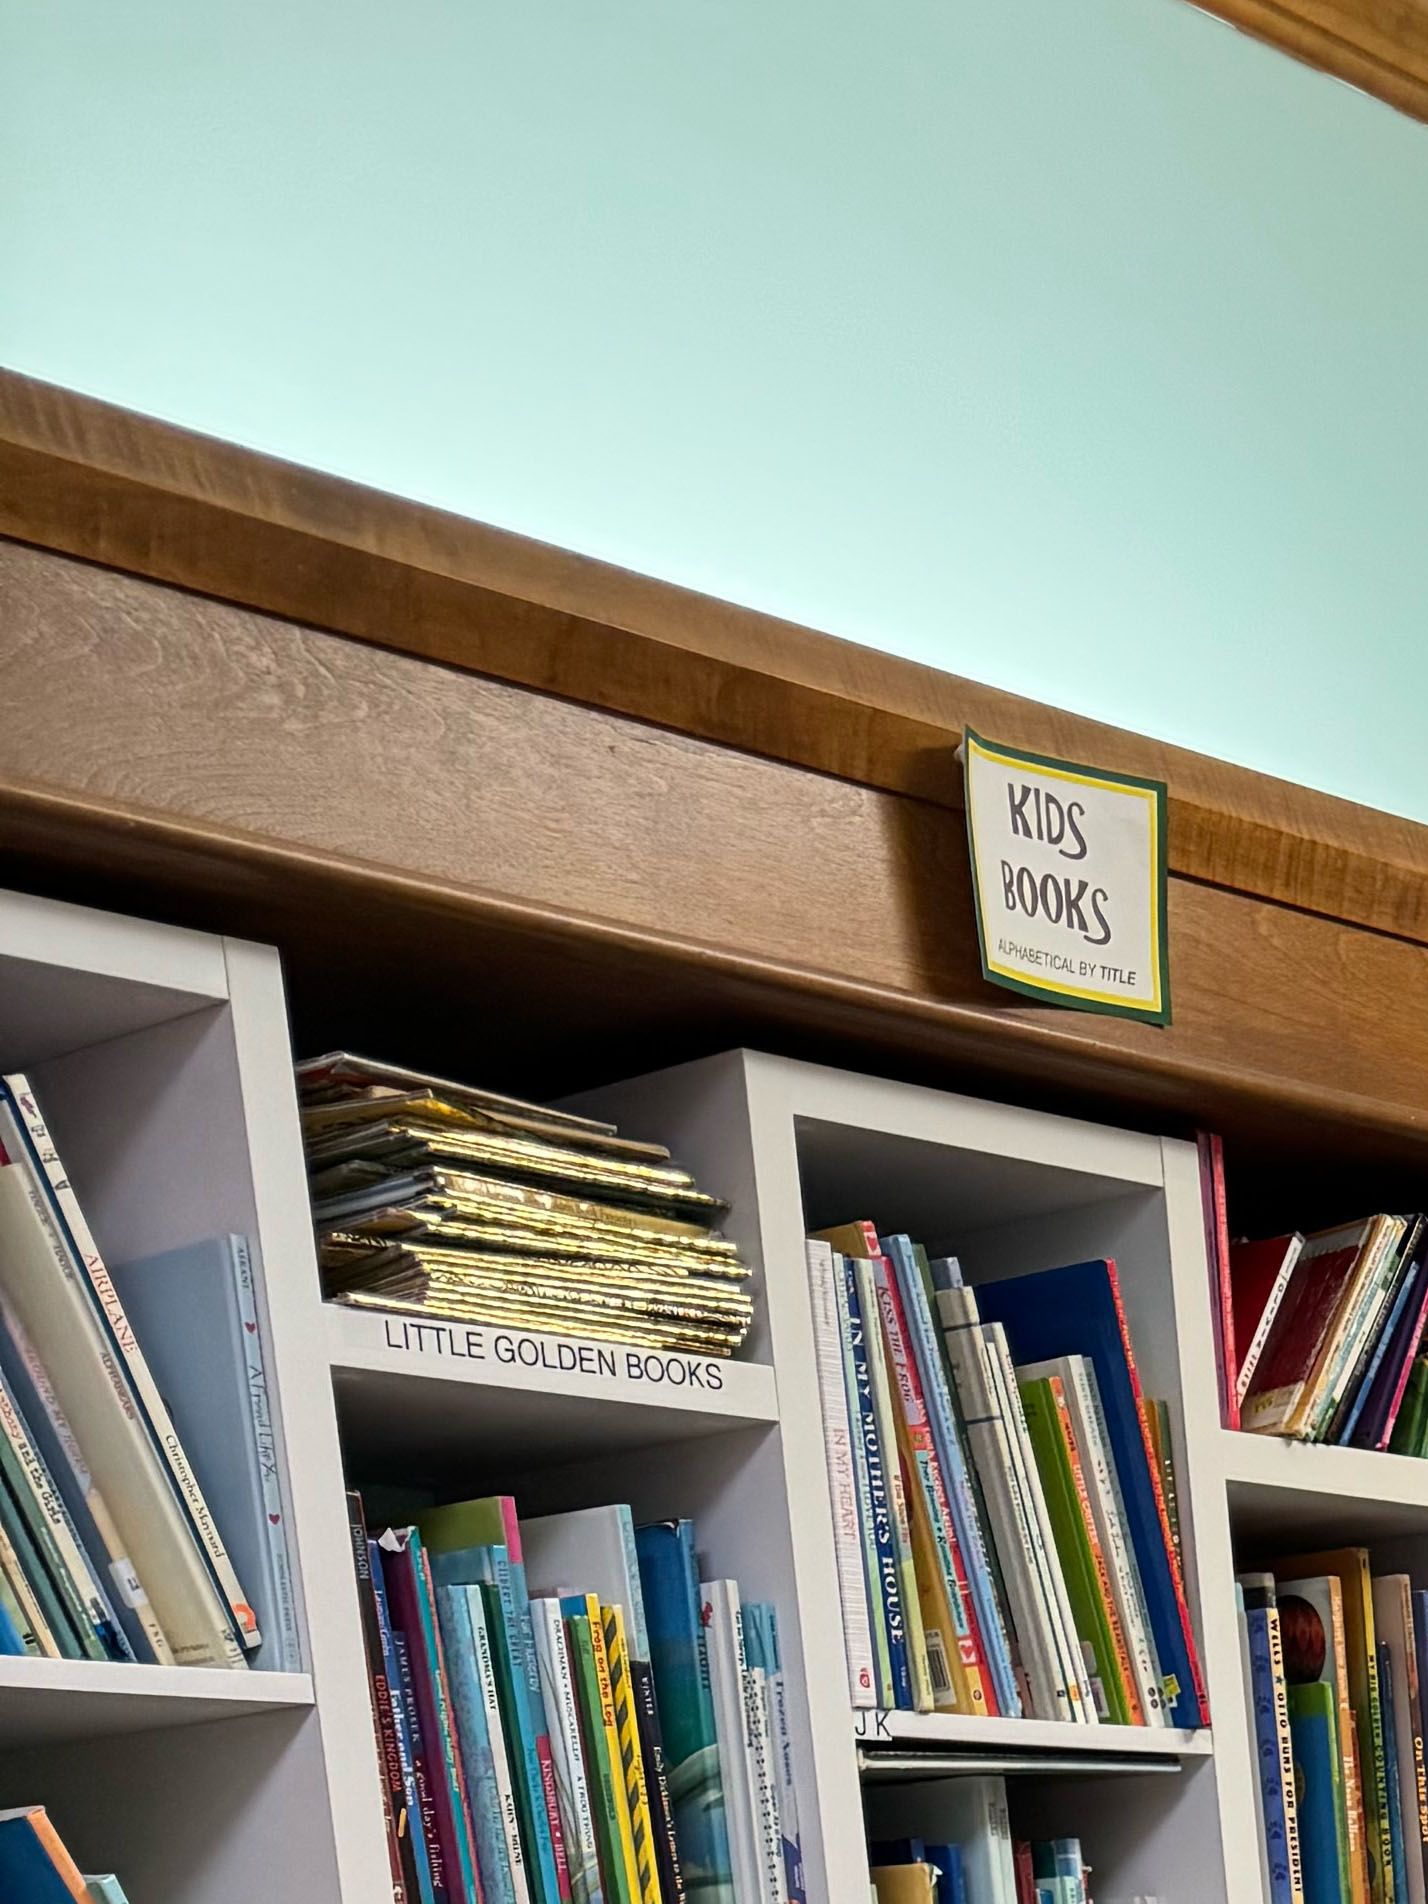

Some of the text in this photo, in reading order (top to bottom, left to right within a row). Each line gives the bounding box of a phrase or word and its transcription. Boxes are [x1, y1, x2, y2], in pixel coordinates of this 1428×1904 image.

[1007, 782, 1088, 860] KIDS
[1001, 859, 1112, 945] BOOKS
[998, 938, 1136, 985] ALPHABETICAL BY TITLE
[82, 1252, 139, 1356] AIRPLANE
[384, 1320, 723, 1390] LITTLE GOLDEN BOOKS
[855, 1361, 904, 1644] MY MOTHER'S HOUSE
[349, 1523, 369, 1580] JOHNSON
[592, 1621, 601, 1653] Frog
[1276, 1692, 1302, 1892] OTTO PRESIDENT
